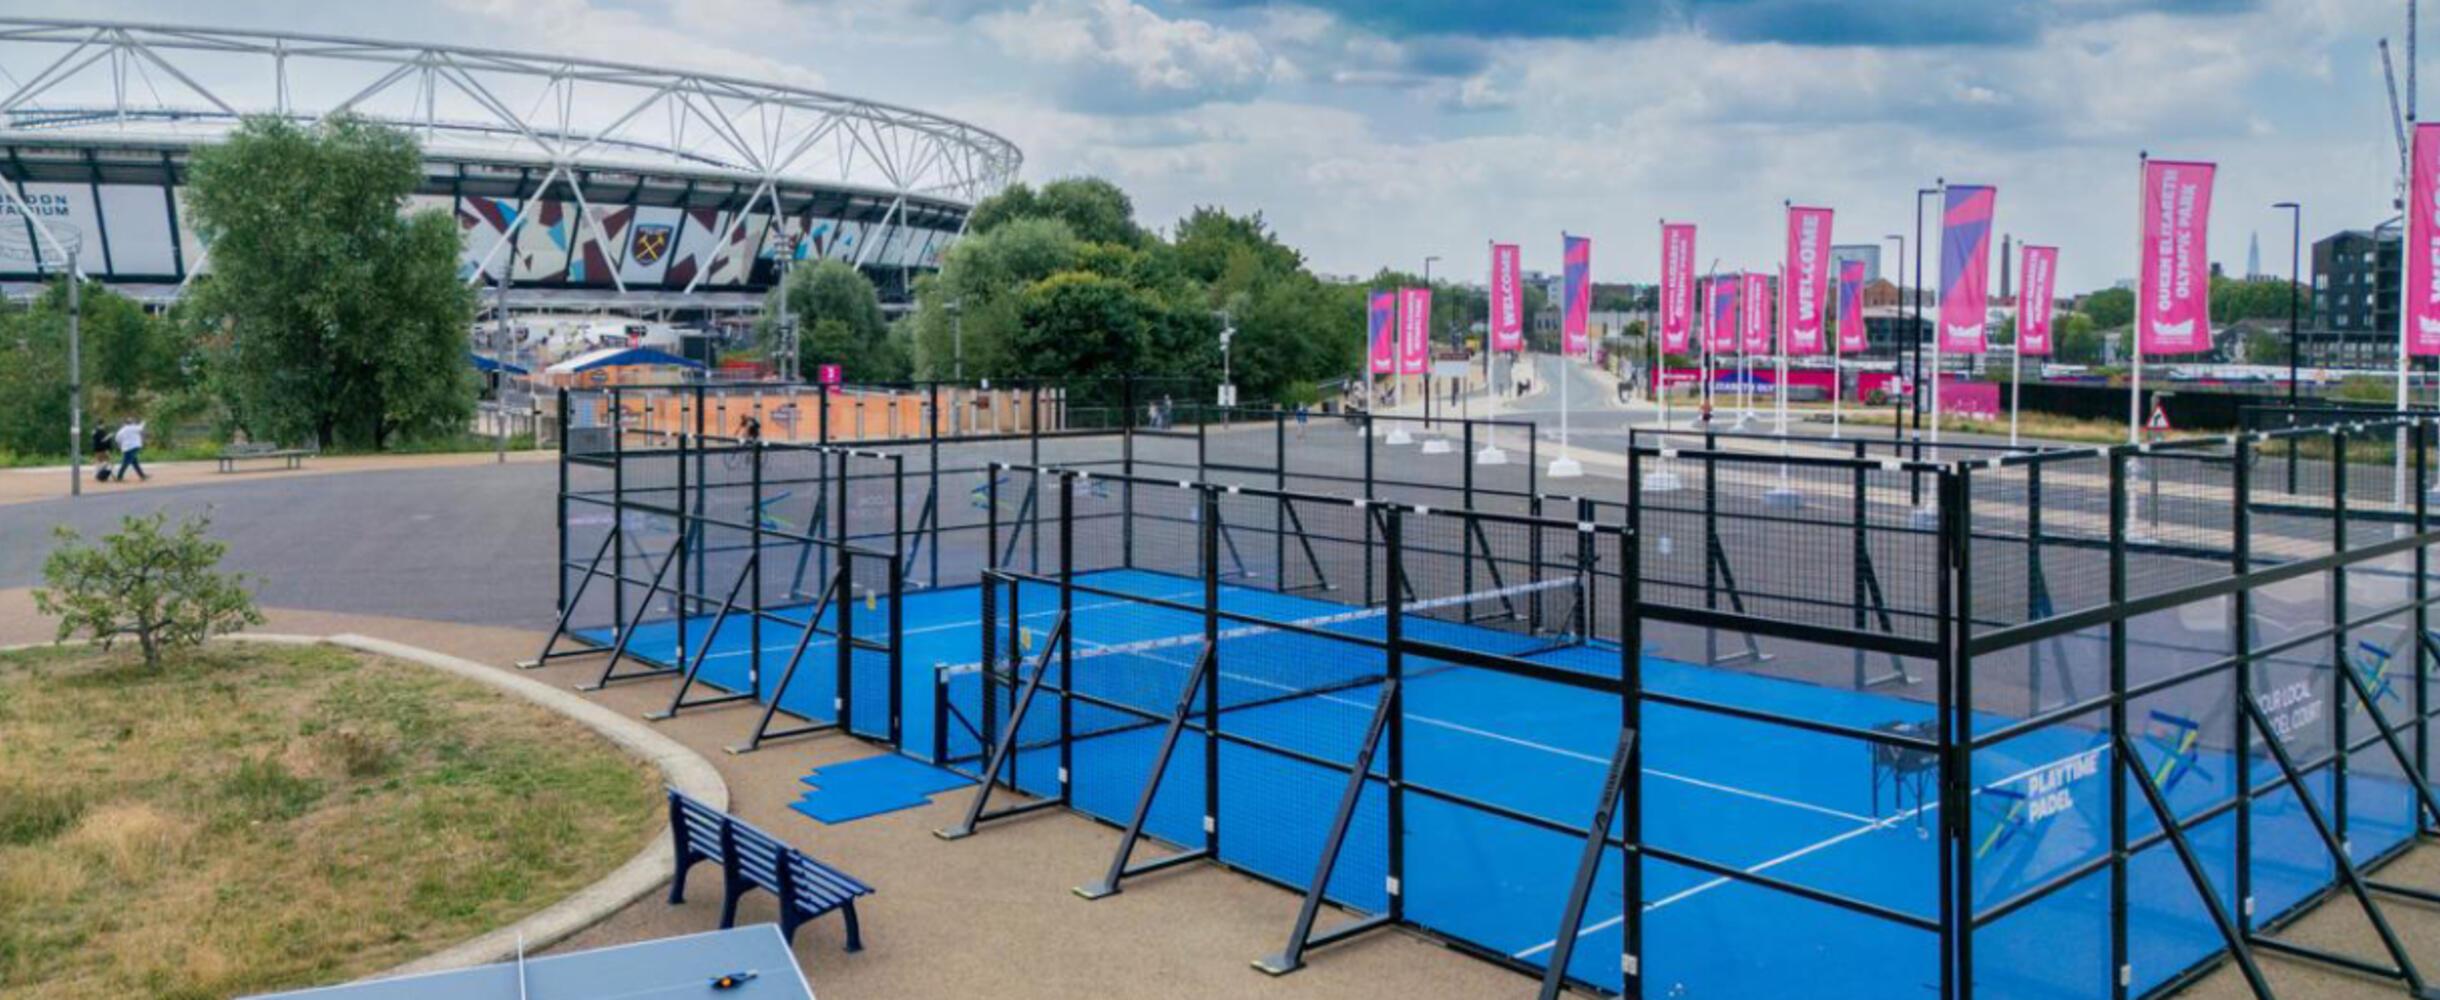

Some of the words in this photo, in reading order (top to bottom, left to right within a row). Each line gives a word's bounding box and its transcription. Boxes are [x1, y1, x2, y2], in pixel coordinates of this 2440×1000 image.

[2159, 169, 2178, 256] ELIZABETH
[2179, 184, 2197, 228] PARK
[1501, 249, 1516, 325] WELCOME
[1799, 214, 1818, 321] WELCOME
[2158, 257, 2172, 311] QUEEN
[2176, 230, 2191, 298] OLYMPIC
[2282, 680, 2311, 707] LOCAL
[2028, 750, 2099, 798] PLAYTIME
[2028, 788, 2073, 822] PADEL
